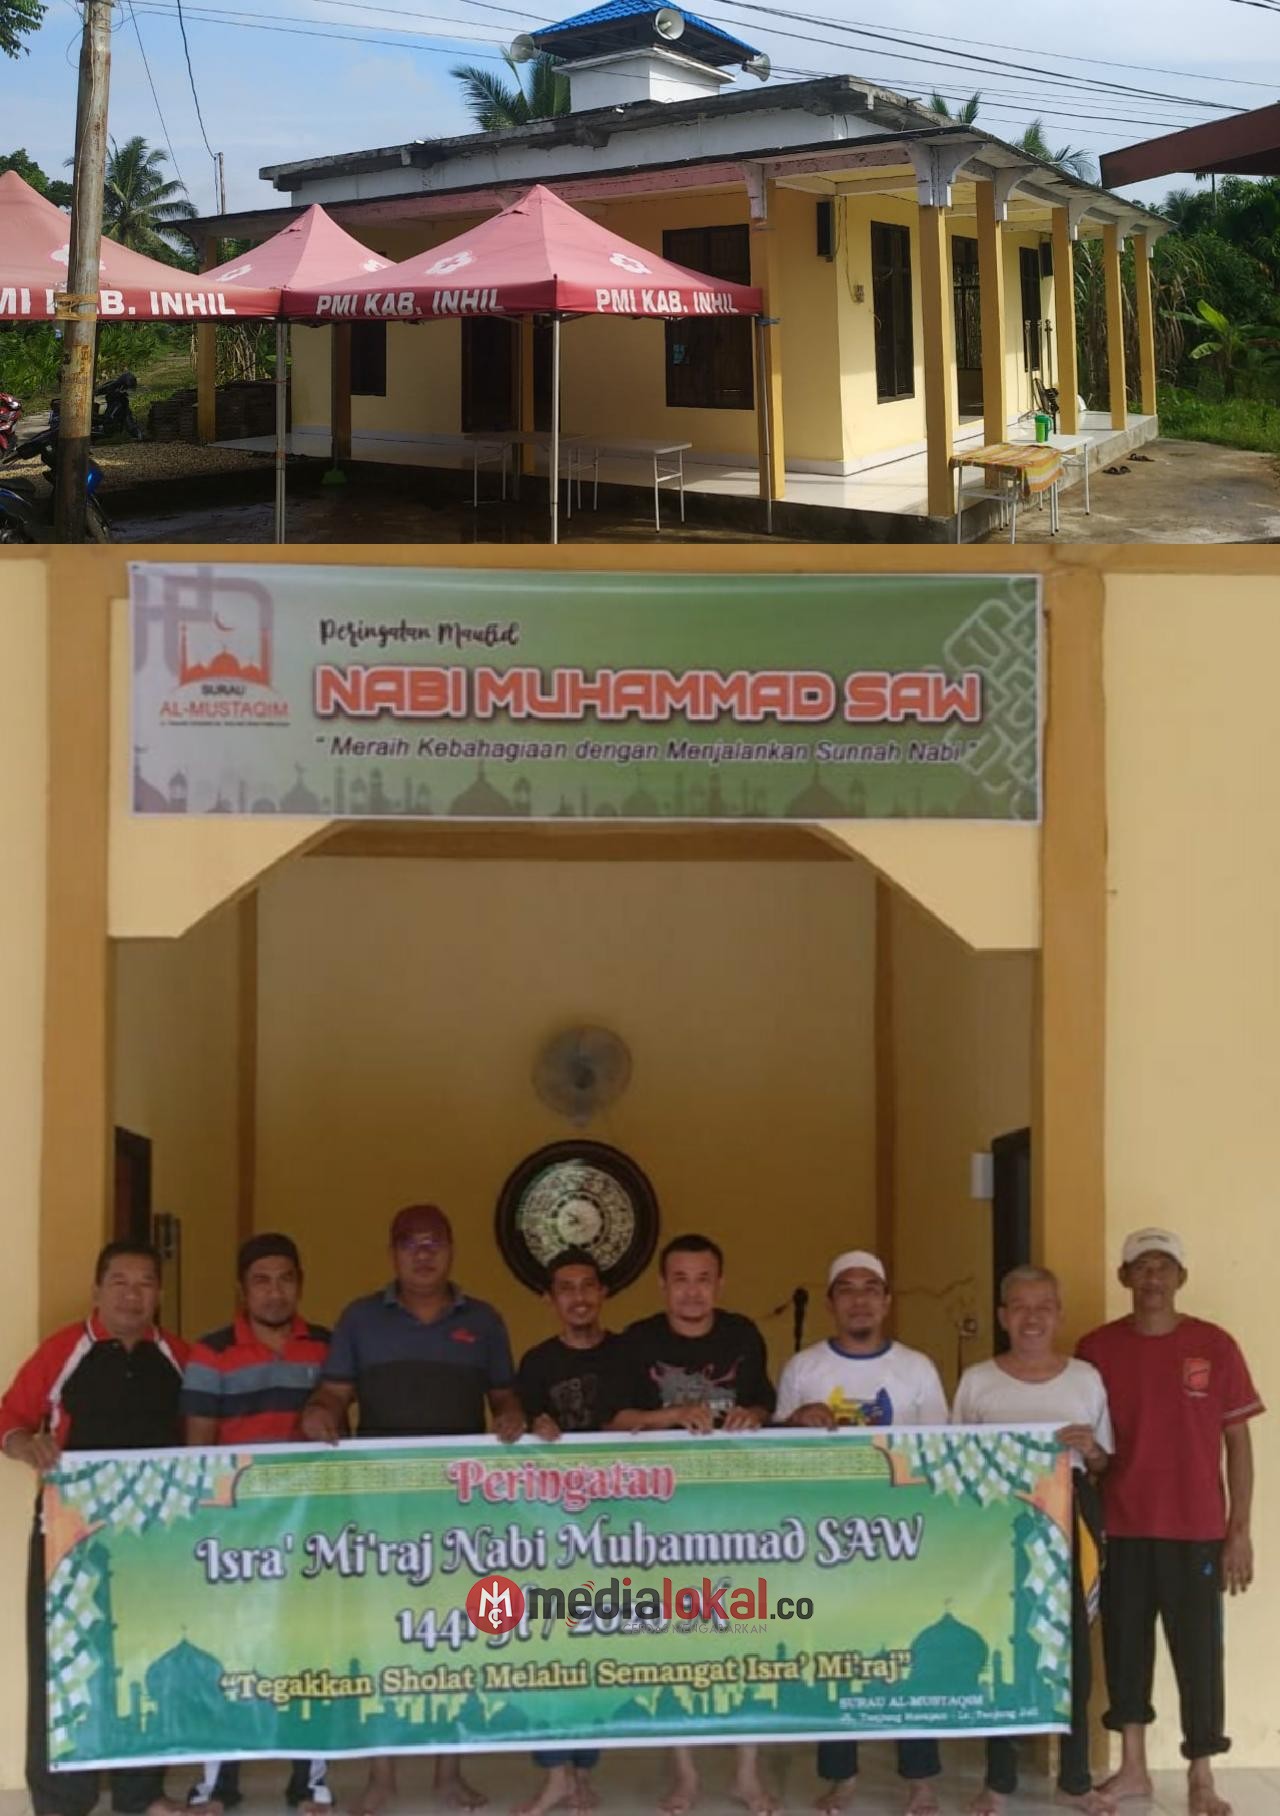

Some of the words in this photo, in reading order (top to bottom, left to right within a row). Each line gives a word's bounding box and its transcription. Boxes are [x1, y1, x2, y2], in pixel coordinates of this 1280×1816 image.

[150, 290, 236, 316] INHIL
[315, 295, 358, 316] PMI
[364, 292, 422, 316] KAB.
[432, 288, 505, 315] INHIL
[595, 288, 636, 313] PMI
[642, 289, 689, 313] KAB.
[693, 292, 739, 314] INHIL
[320, 619, 432, 647] Peringatan
[437, 622, 519, 650] Maulid
[201, 684, 245, 696] SURAU
[315, 664, 467, 719] NABI
[474, 666, 836, 722] MUHAMMAD
[844, 671, 984, 723] SAW
[160, 700, 289, 718] AL-MUSTAQIM
[330, 736, 409, 756] Meraih
[417, 738, 567, 762] Kebahagiaan
[574, 741, 658, 764] dengan
[666, 742, 808, 765] Menjalankan
[816, 743, 900, 763] Sunnah
[908, 744, 962, 763] Nabi
[448, 1459, 676, 1512] Peringatan
[196, 1535, 294, 1582] Isra'
[302, 1521, 434, 1584] Mi'raj
[442, 1525, 547, 1575] Nabi
[557, 1515, 806, 1568] Muhammad
[814, 1514, 924, 1568] SAW
[381, 1663, 475, 1693] Sholat
[484, 1660, 590, 1691] Melalui
[597, 1659, 739, 1688] Semangat
